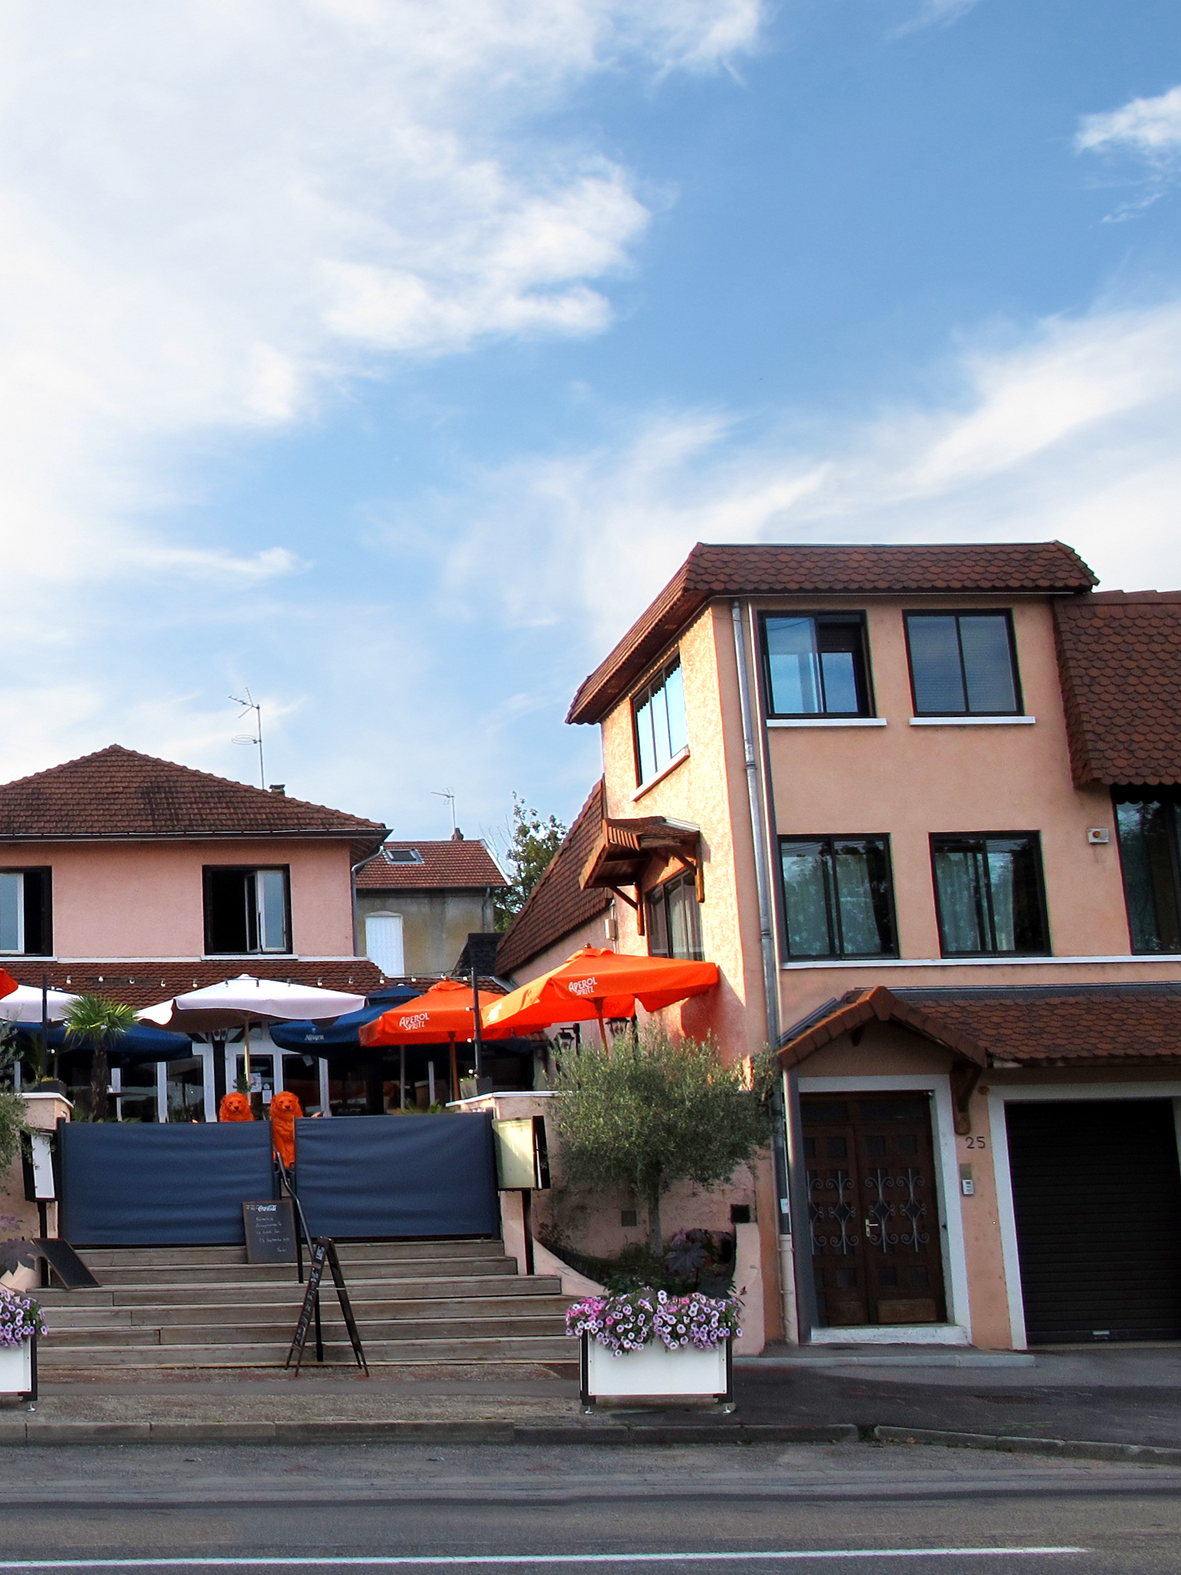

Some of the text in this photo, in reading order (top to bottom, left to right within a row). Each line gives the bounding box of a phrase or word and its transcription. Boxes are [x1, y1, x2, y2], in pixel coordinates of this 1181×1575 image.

[568, 976, 598, 993] APEROL
[399, 1012, 430, 1027] APEROL
[965, 1136, 986, 1149] 25
